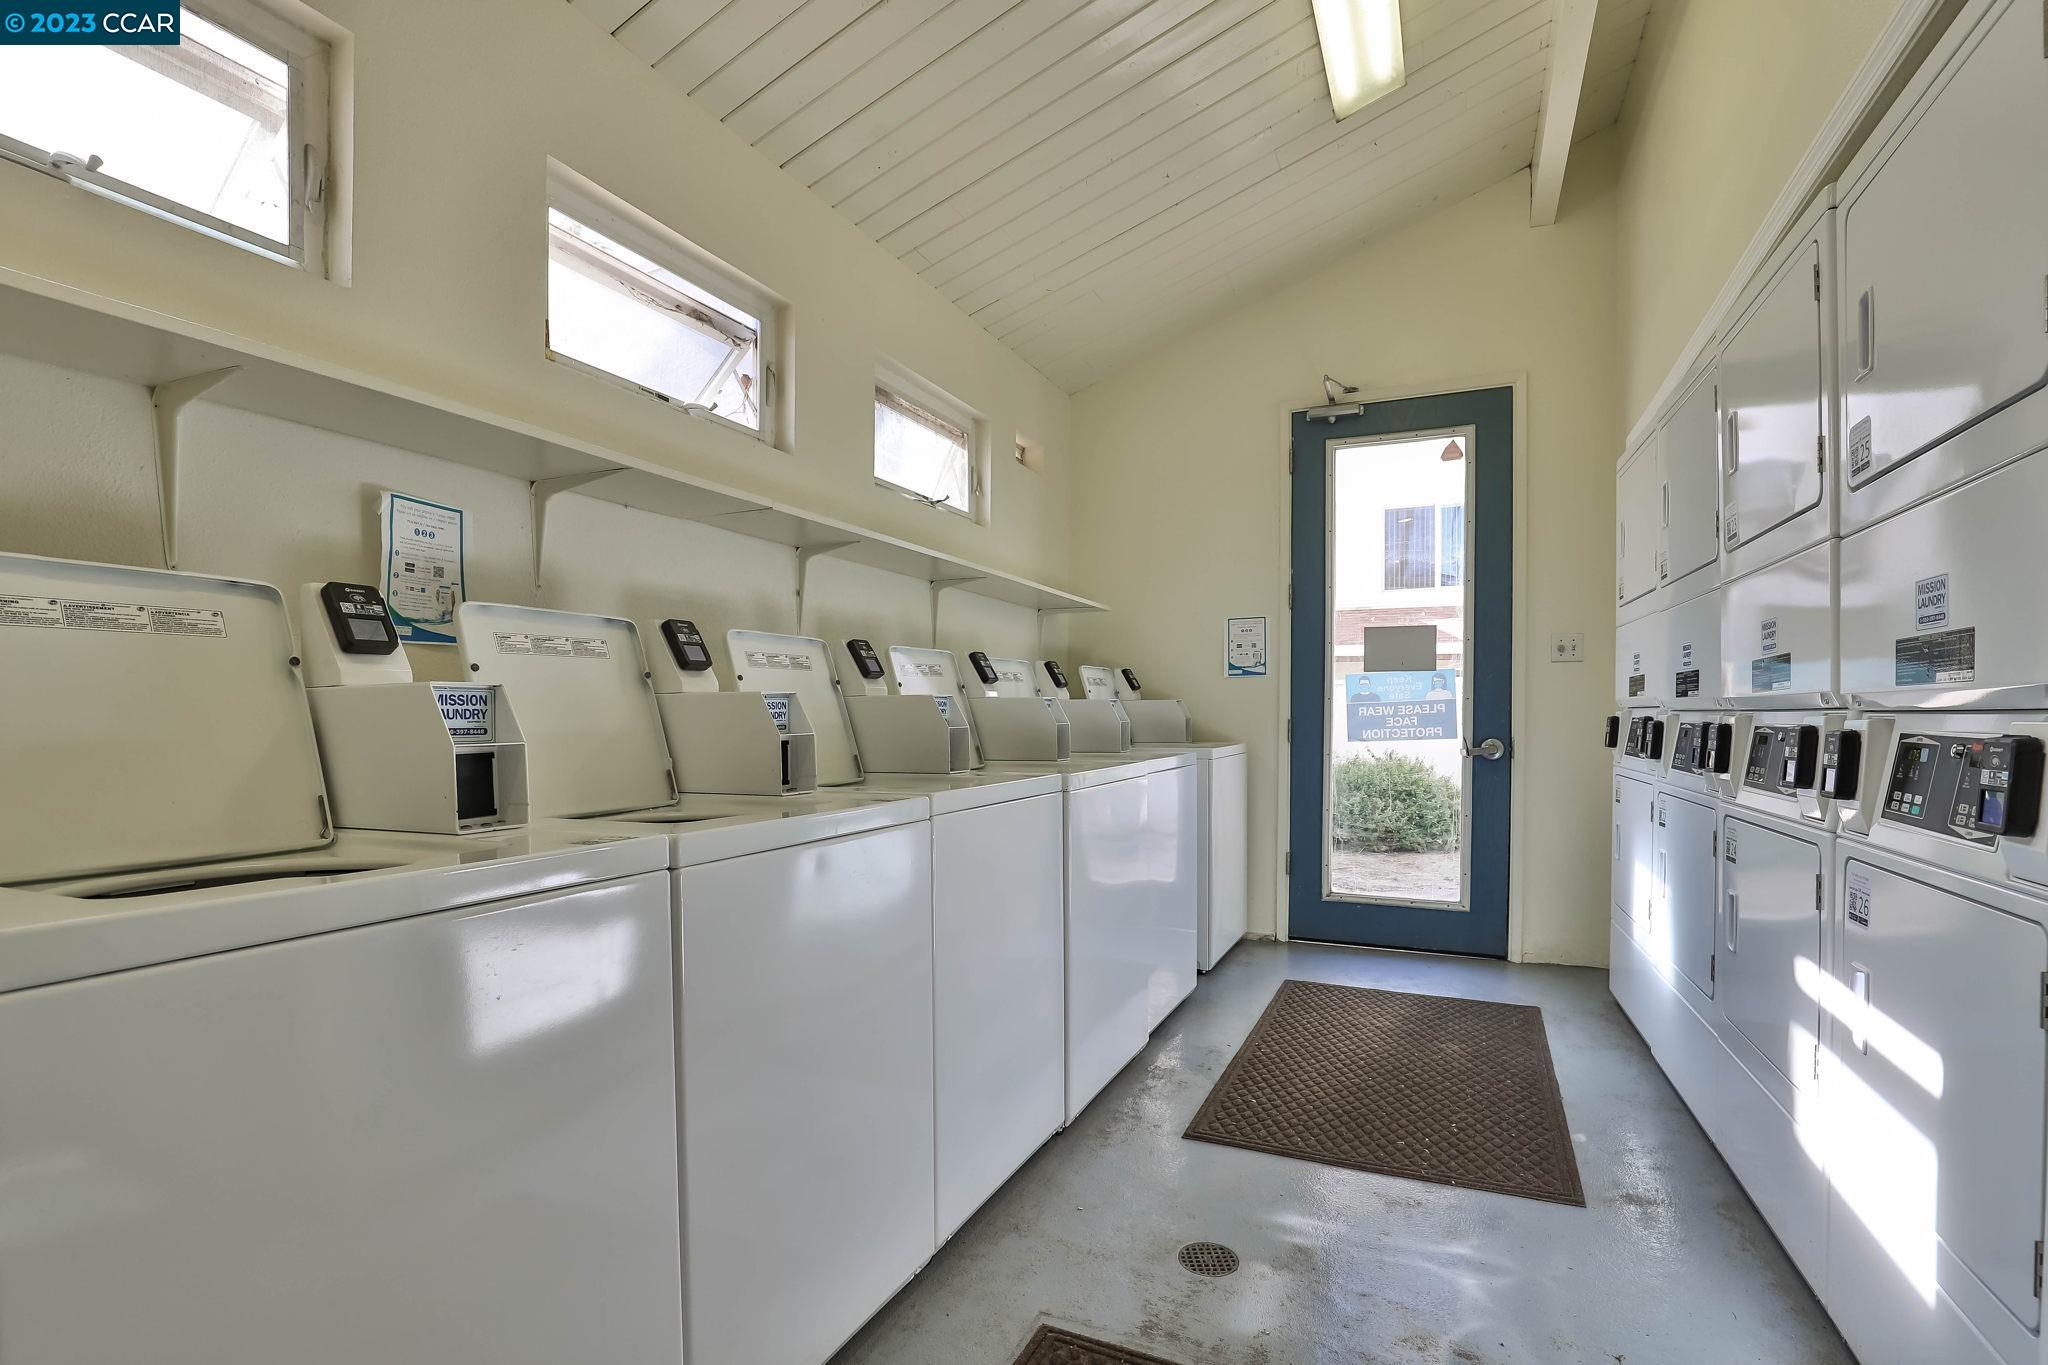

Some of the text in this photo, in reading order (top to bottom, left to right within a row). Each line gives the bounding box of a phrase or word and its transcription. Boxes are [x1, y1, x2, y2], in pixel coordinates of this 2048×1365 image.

[1859, 440, 1870, 462] 25
[1917, 578, 1946, 596] MISSION
[68, 603, 115, 611] AVERTISSEMENT
[1917, 592, 1947, 609] LAUNDRY
[1858, 896, 1869, 917] 26
